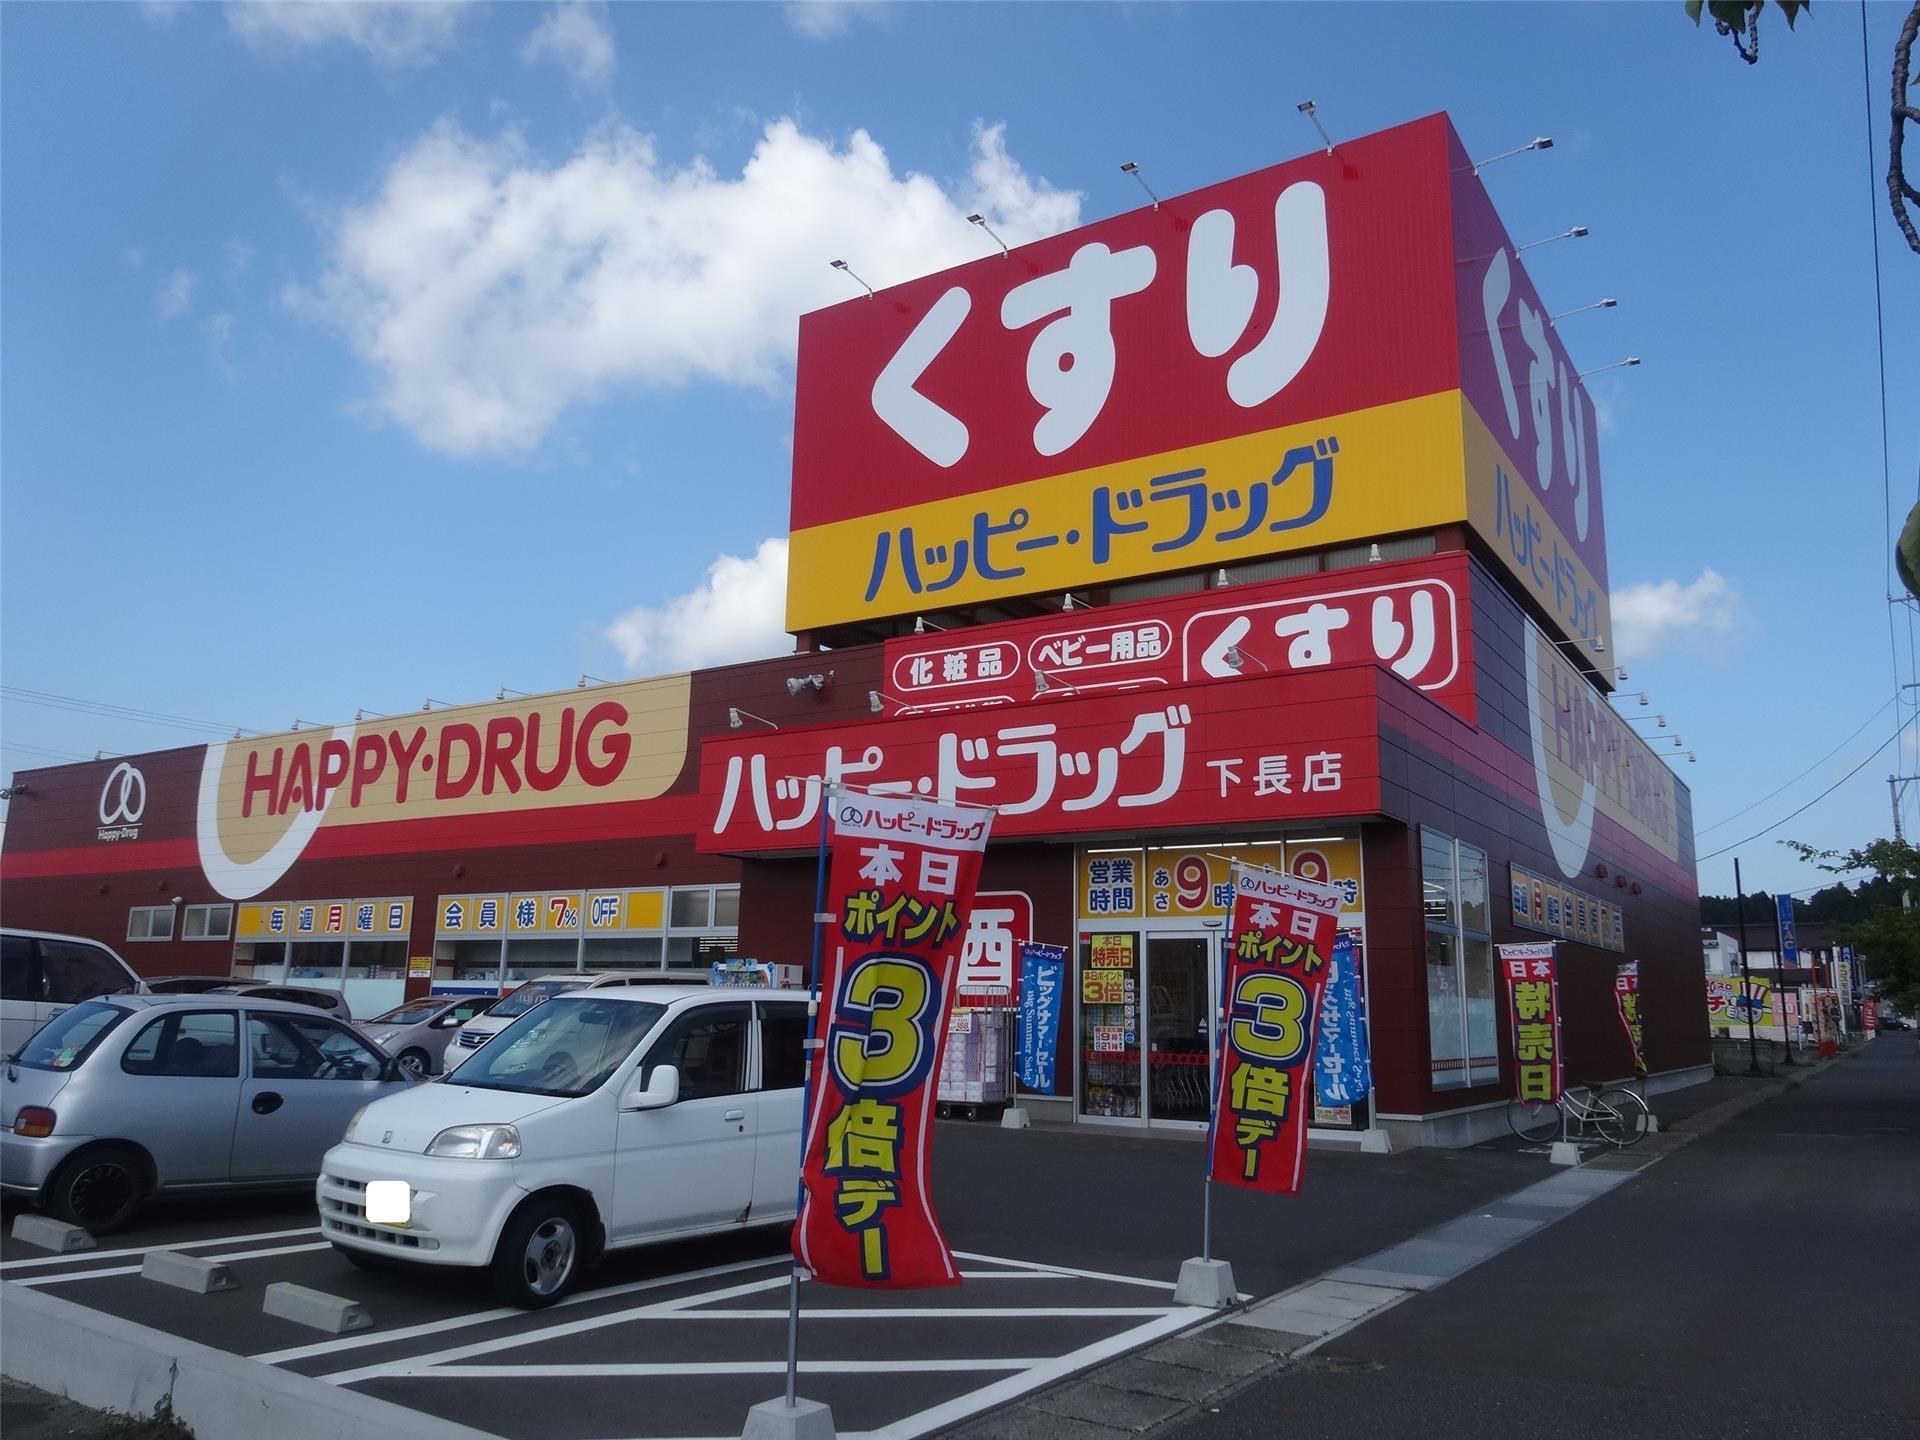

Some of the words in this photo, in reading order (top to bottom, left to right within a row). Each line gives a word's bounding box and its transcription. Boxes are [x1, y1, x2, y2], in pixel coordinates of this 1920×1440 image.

[871, 181, 1331, 467] くすり
[1483, 246, 1588, 543] くすり
[864, 437, 1339, 602] ハッピー・ドラッグ
[1038, 625, 1162, 666] ベビー用品
[1201, 590, 1433, 678] くすり
[909, 648, 1002, 686] 化粧品
[1206, 750, 1343, 798] 下長店
[863, 809, 986, 842] ハッピー・ドラッグ
[858, 843, 960, 896] 本日
[1090, 860, 1133, 884] 営業
[268, 902, 403, 933] 毎週月曜日
[843, 892, 959, 943] ポイント
[1090, 887, 1133, 911] 時間
[1248, 902, 1319, 940] 本日
[1093, 947, 1132, 967] 特売日
[1237, 930, 1323, 973] ポイント
[1084, 981, 1122, 1003] 3倍
[1024, 1008, 1035, 1054] Summer
[1033, 965, 1057, 1089] ビッグサマーセール
[1230, 973, 1306, 1177] 3倍デー
[825, 957, 932, 1274] 3倍デー
